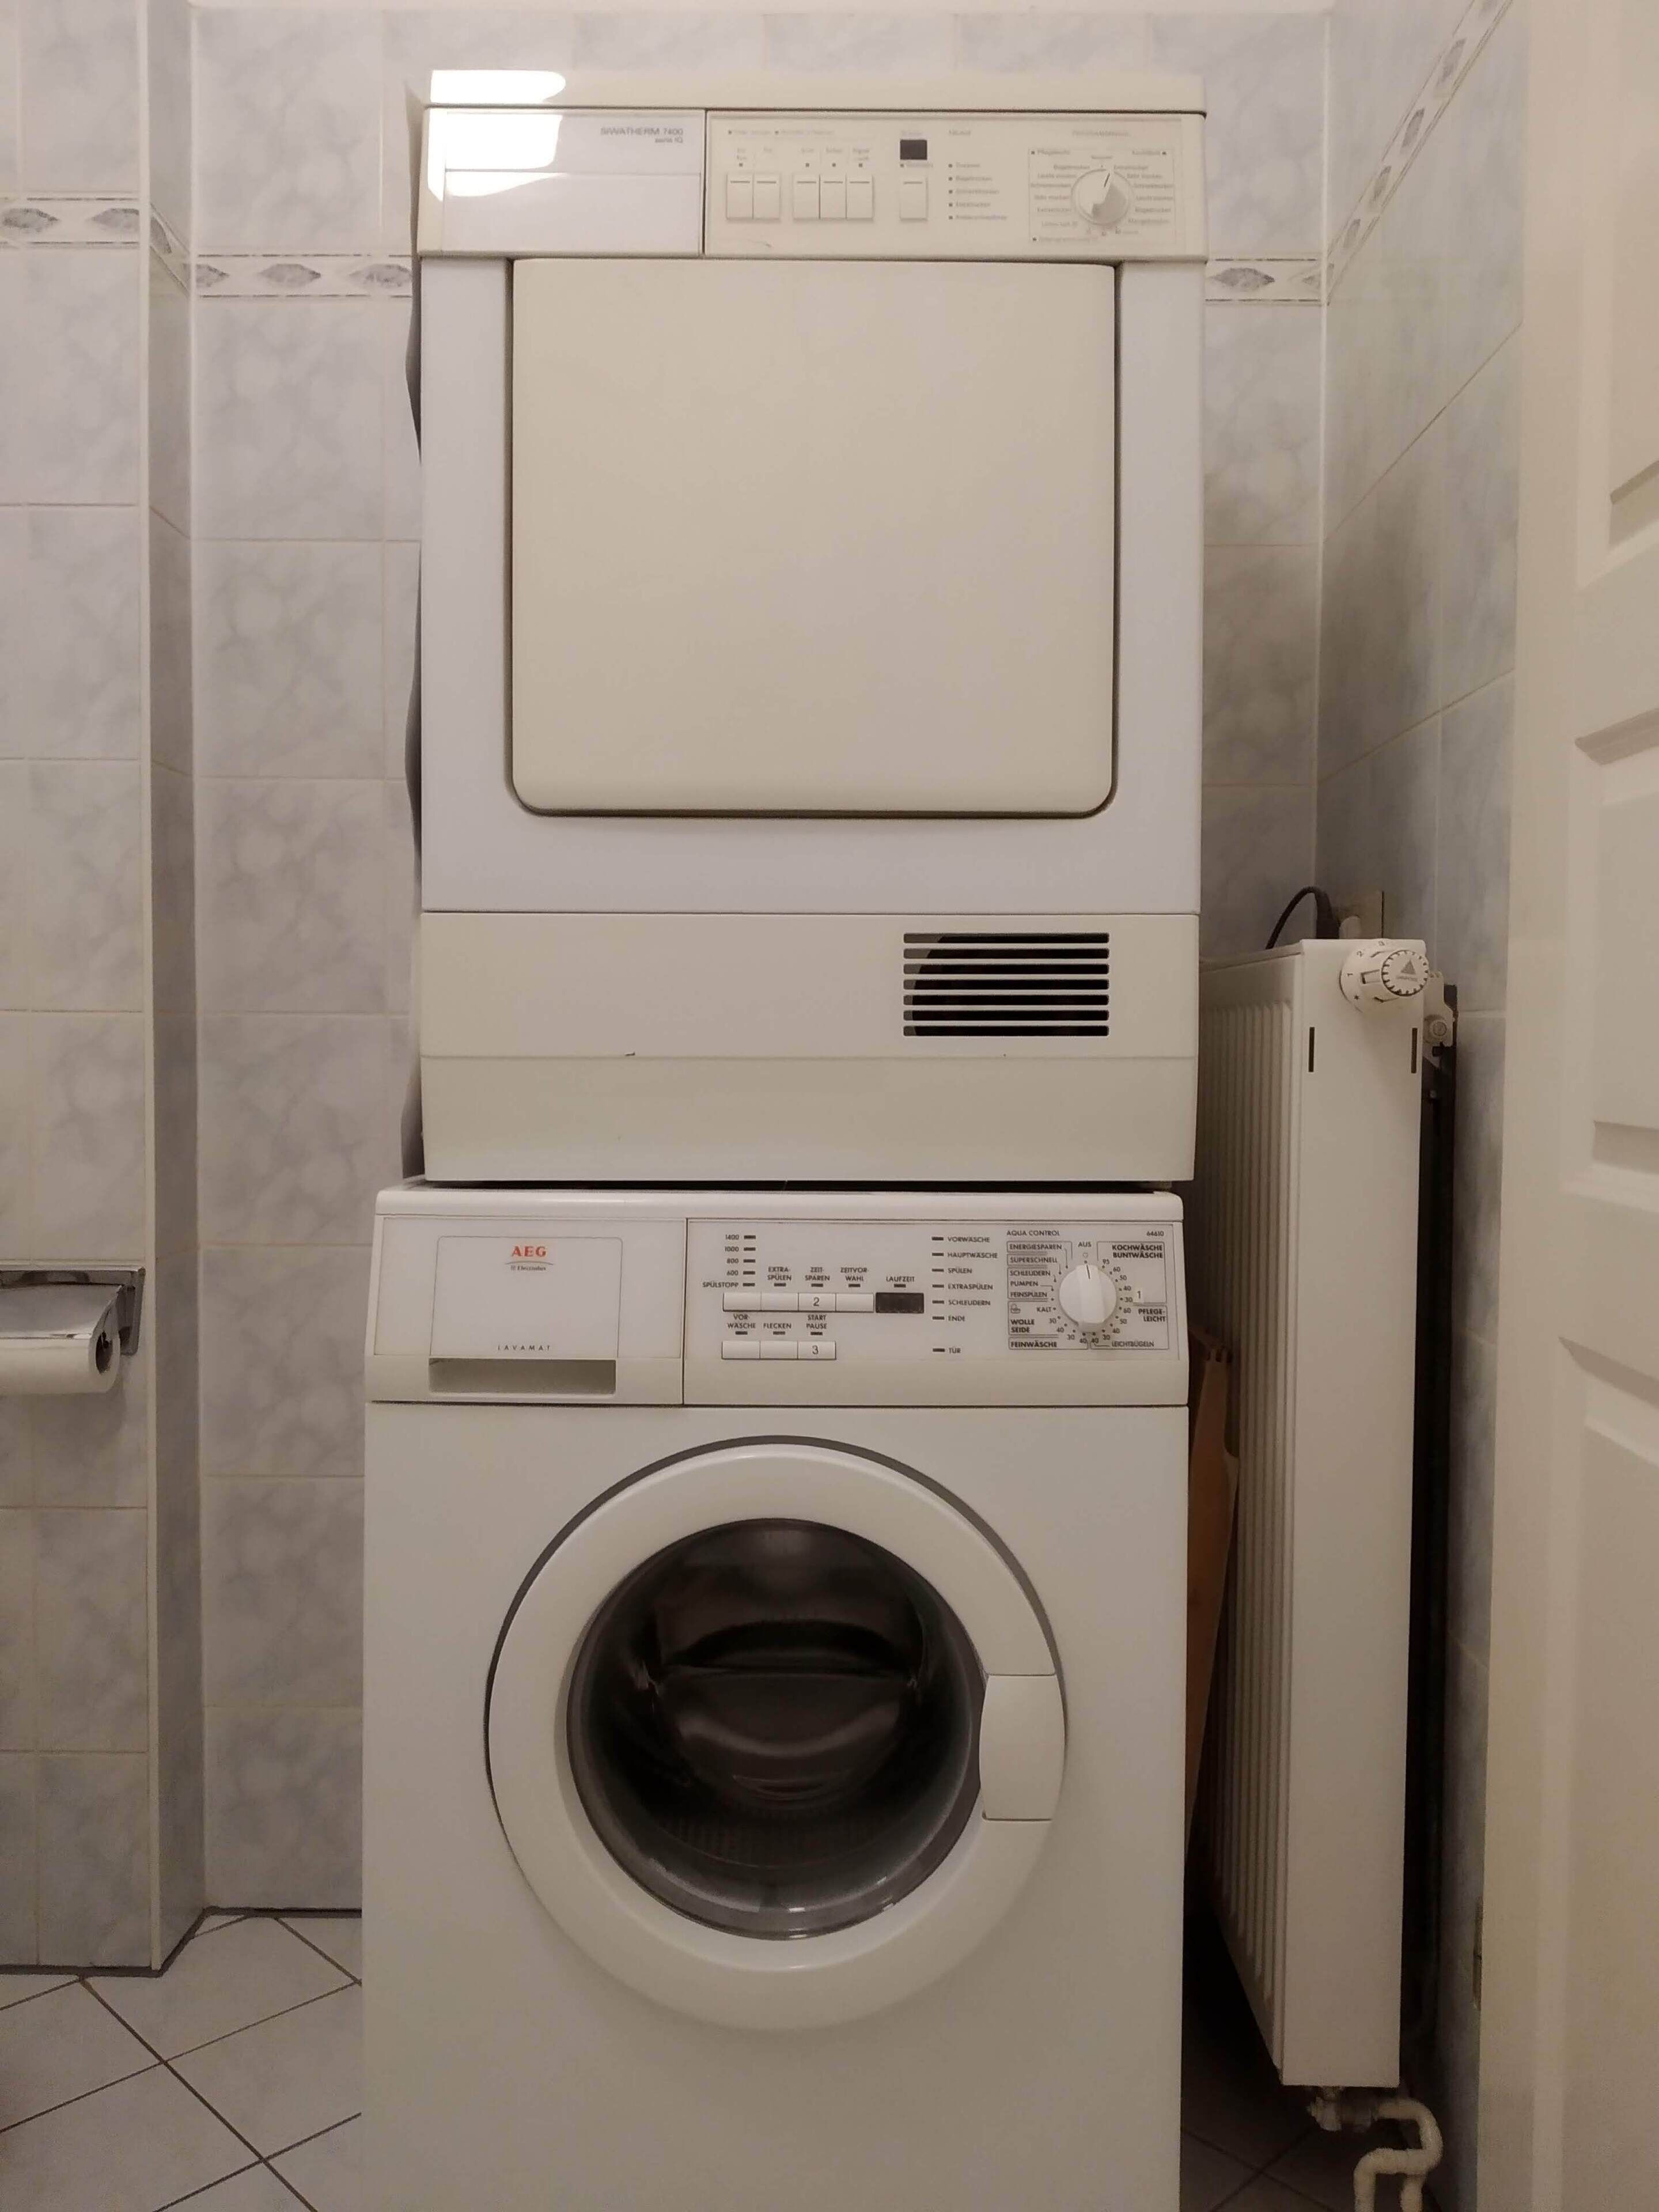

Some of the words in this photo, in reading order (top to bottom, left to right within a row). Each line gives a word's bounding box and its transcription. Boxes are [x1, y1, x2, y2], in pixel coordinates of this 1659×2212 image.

[511, 1245, 547, 1257] AEG
[1112, 1243, 1163, 1251] KOCHWÄSCHE
[1137, 1290, 1142, 1300] 1
[813, 1297, 820, 1307] 2
[1010, 1340, 1058, 1348] FEINWÄSCHE
[812, 1344, 819, 1355] 3
